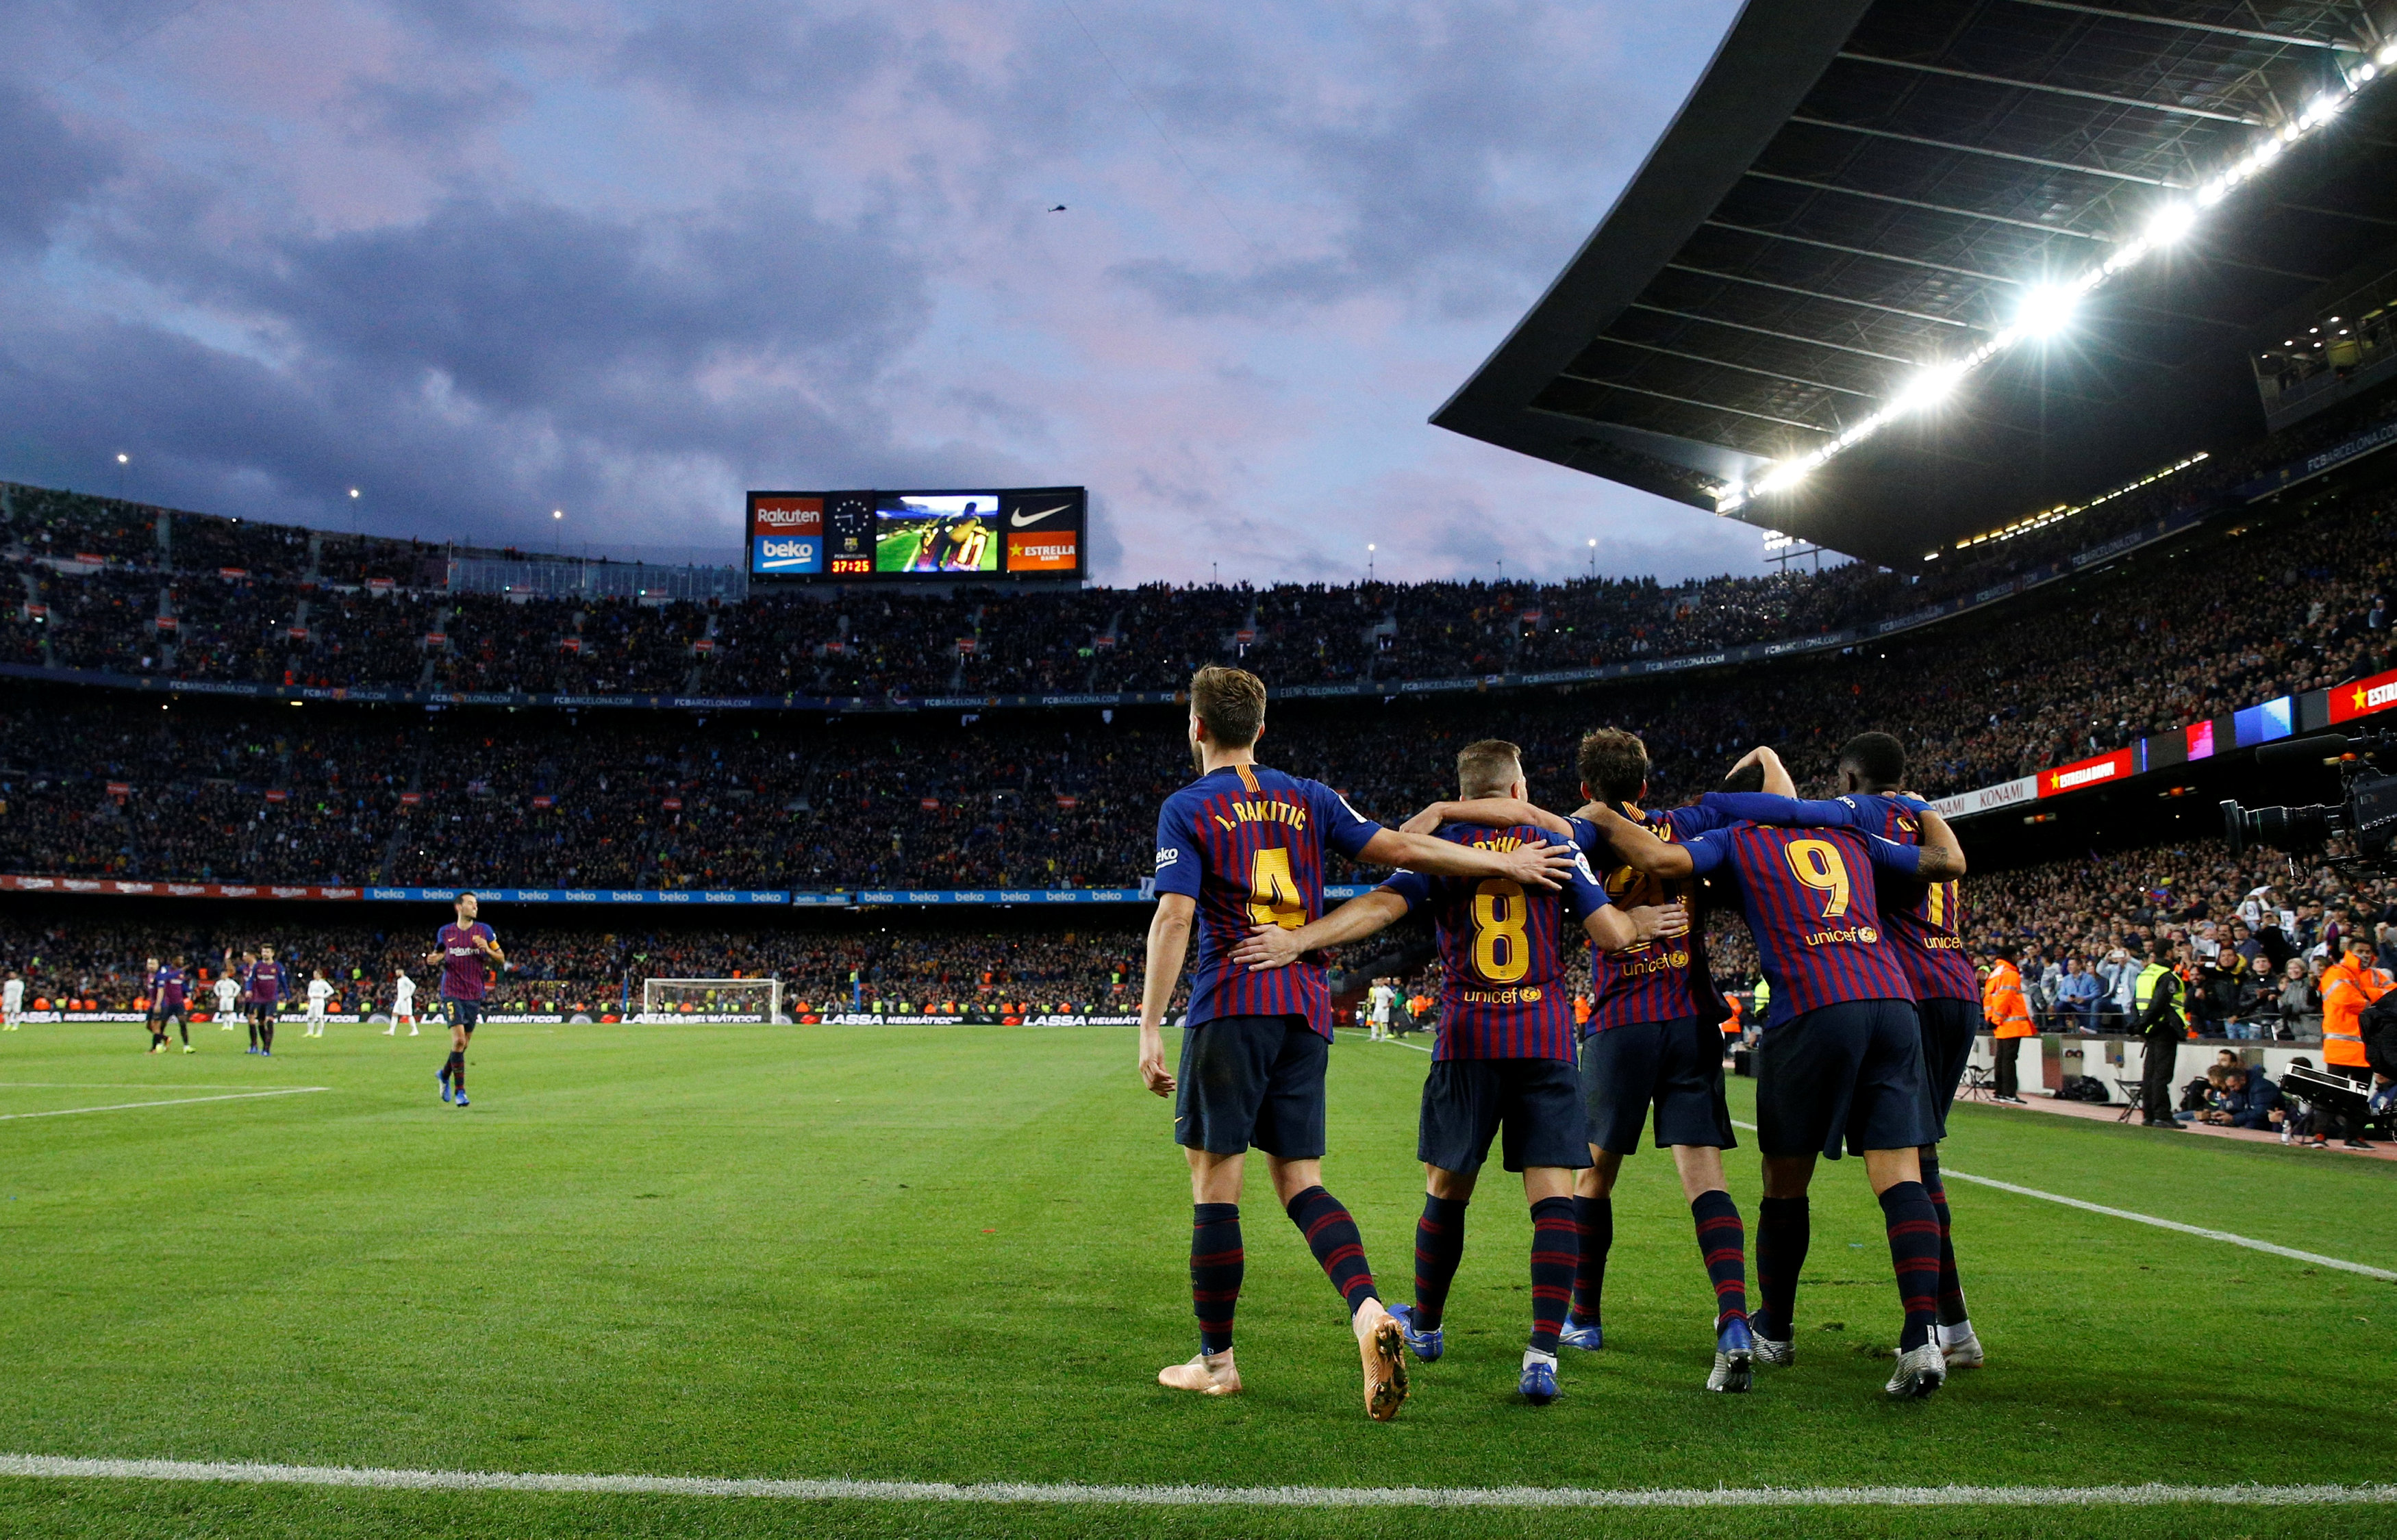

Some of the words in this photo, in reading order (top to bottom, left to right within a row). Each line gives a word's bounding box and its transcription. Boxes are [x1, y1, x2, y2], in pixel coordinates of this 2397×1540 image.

[757, 508, 820, 522] Rakuten
[763, 540, 813, 557] beko
[1025, 545, 1075, 557] ESTRELLA
[833, 561, 869, 572] 37:25
[1646, 654, 1724, 672] FCBARCELONA.COM
[554, 696, 633, 705] FCBARCELONA.COM
[675, 698, 751, 707] FCBARCELONA.COM
[1042, 695, 1120, 705] FCBARCELONA.COM
[1932, 797, 1965, 816] ONAMI
[1980, 782, 2023, 808] KONAMI
[1215, 814, 1237, 832] I.
[1232, 800, 1306, 831] RAKITIĆ
[1156, 847, 1179, 863] eko
[1784, 839, 1849, 918] 9
[374, 889, 405, 899] beko
[1246, 847, 1307, 930] 4
[1324, 887, 1354, 896] beko
[423, 889, 454, 900] beko
[518, 890, 549, 900] beko
[566, 891, 596, 901] beko
[612, 892, 642, 901] beko
[659, 892, 689, 901] beko
[705, 892, 736, 902] beko
[751, 892, 781, 902] beko
[864, 892, 894, 902] beko
[909, 892, 939, 902] beko
[955, 892, 985, 901] beko
[1001, 892, 1030, 901] beko
[1046, 892, 1076, 900] beko
[1092, 891, 1122, 900] beko
[1470, 878, 1530, 984] 8
[1805, 926, 1857, 946] unicef
[1623, 953, 1670, 976] unicef
[1464, 987, 1518, 1004] unicef
[447, 1002, 455, 1014] 5
[63, 1011, 147, 1022] NEUMÁTICOS
[486, 1013, 562, 1023] NEUMÁTICOS
[820, 1014, 883, 1025] LASSA
[1023, 1015, 1086, 1026] LASSA
